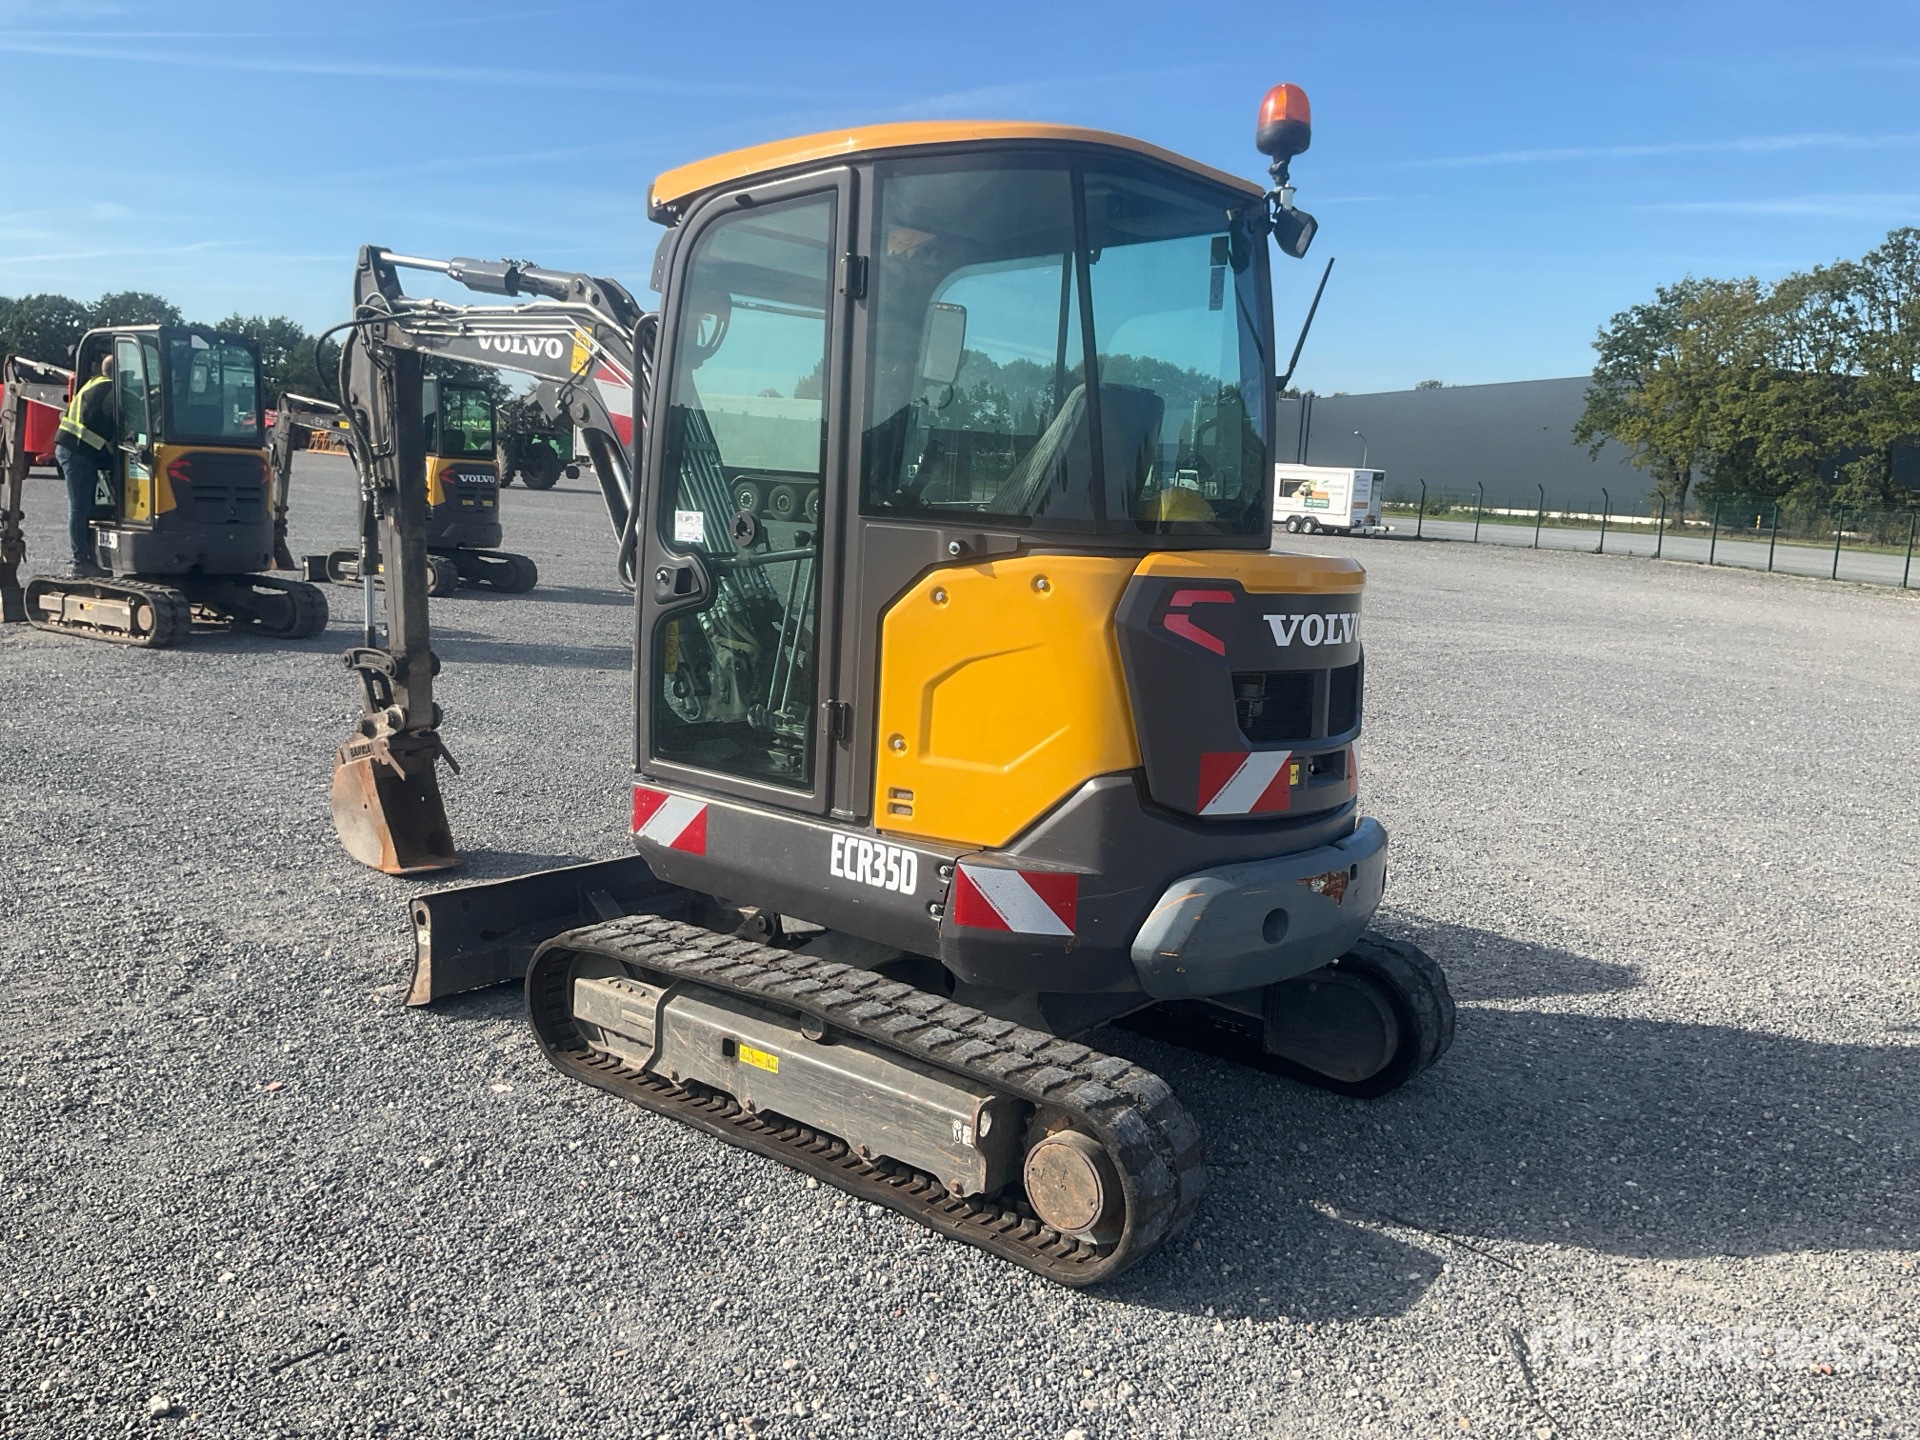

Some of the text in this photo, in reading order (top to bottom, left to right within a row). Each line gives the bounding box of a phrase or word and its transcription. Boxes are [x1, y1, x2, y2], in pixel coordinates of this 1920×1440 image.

[474, 330, 563, 359] VOLVO
[458, 474, 495, 483] VOLVO
[1263, 612, 1360, 646] VOLVO
[830, 833, 918, 895] ECR35D
